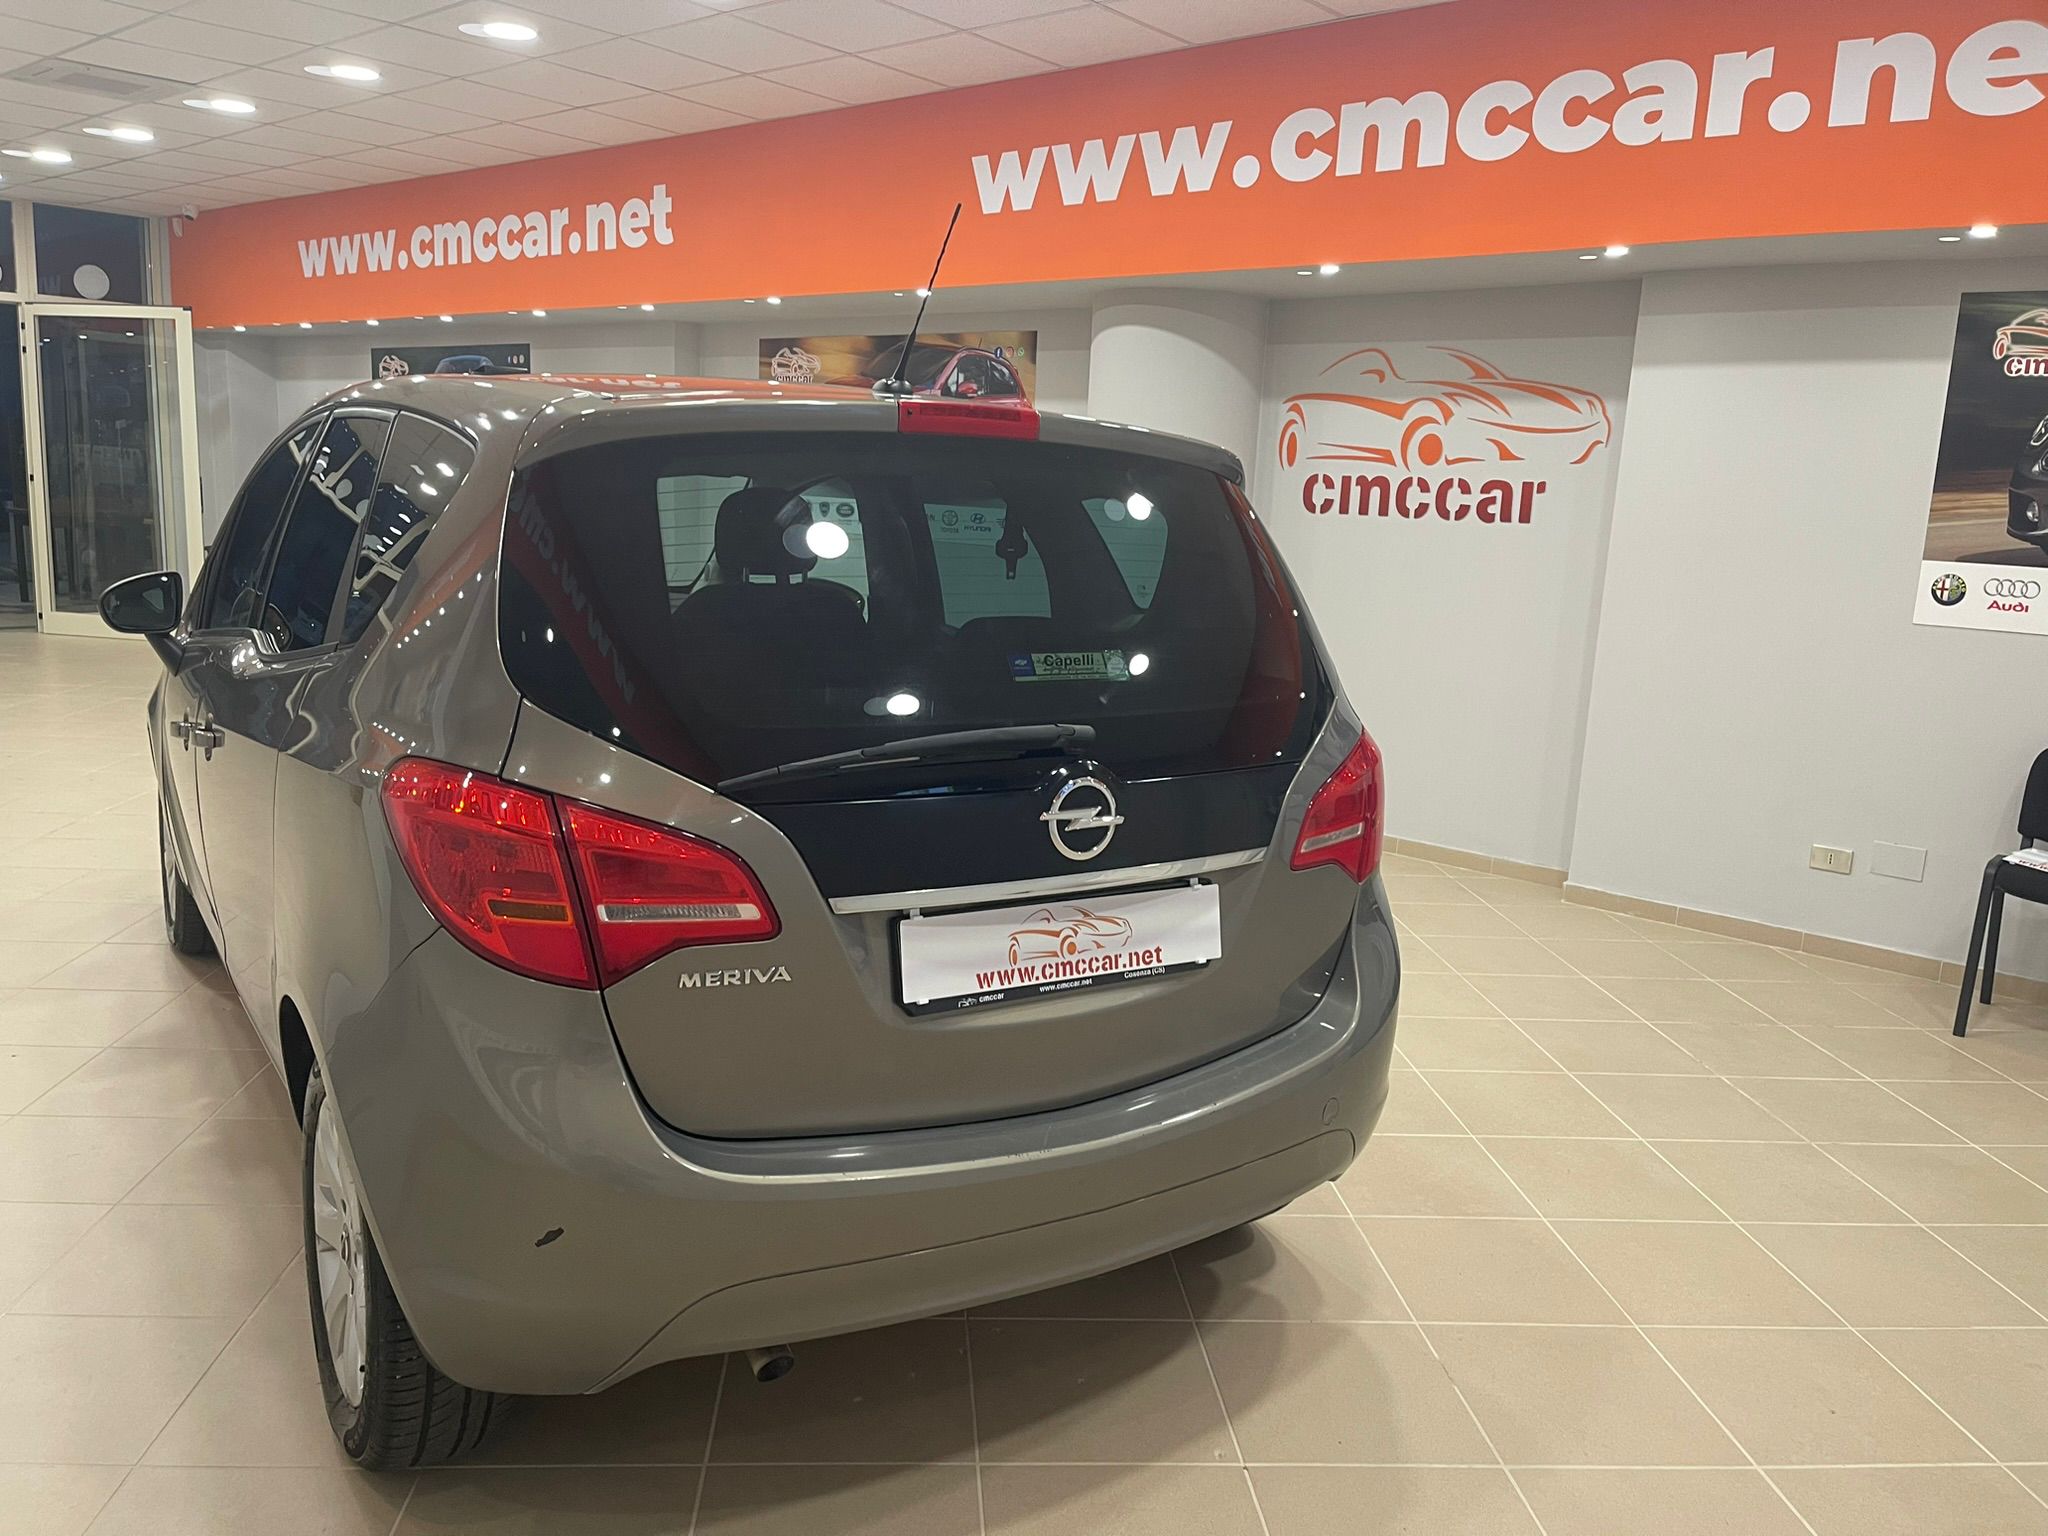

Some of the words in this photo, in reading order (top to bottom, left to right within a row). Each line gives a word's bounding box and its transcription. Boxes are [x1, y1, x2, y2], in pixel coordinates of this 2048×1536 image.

[298, 184, 673, 278] www.cmccar.net
[1303, 473, 1547, 524] cmccar
[1987, 600, 2029, 612] Audi
[1043, 654, 1094, 669] Capelli
[976, 945, 1163, 989] www.cmccar.net
[1124, 969, 1151, 979] Cosenza
[679, 966, 792, 989] MERIVA
[1039, 978, 1093, 993] www.cmccar.net
[979, 992, 1005, 1003] cmccar
